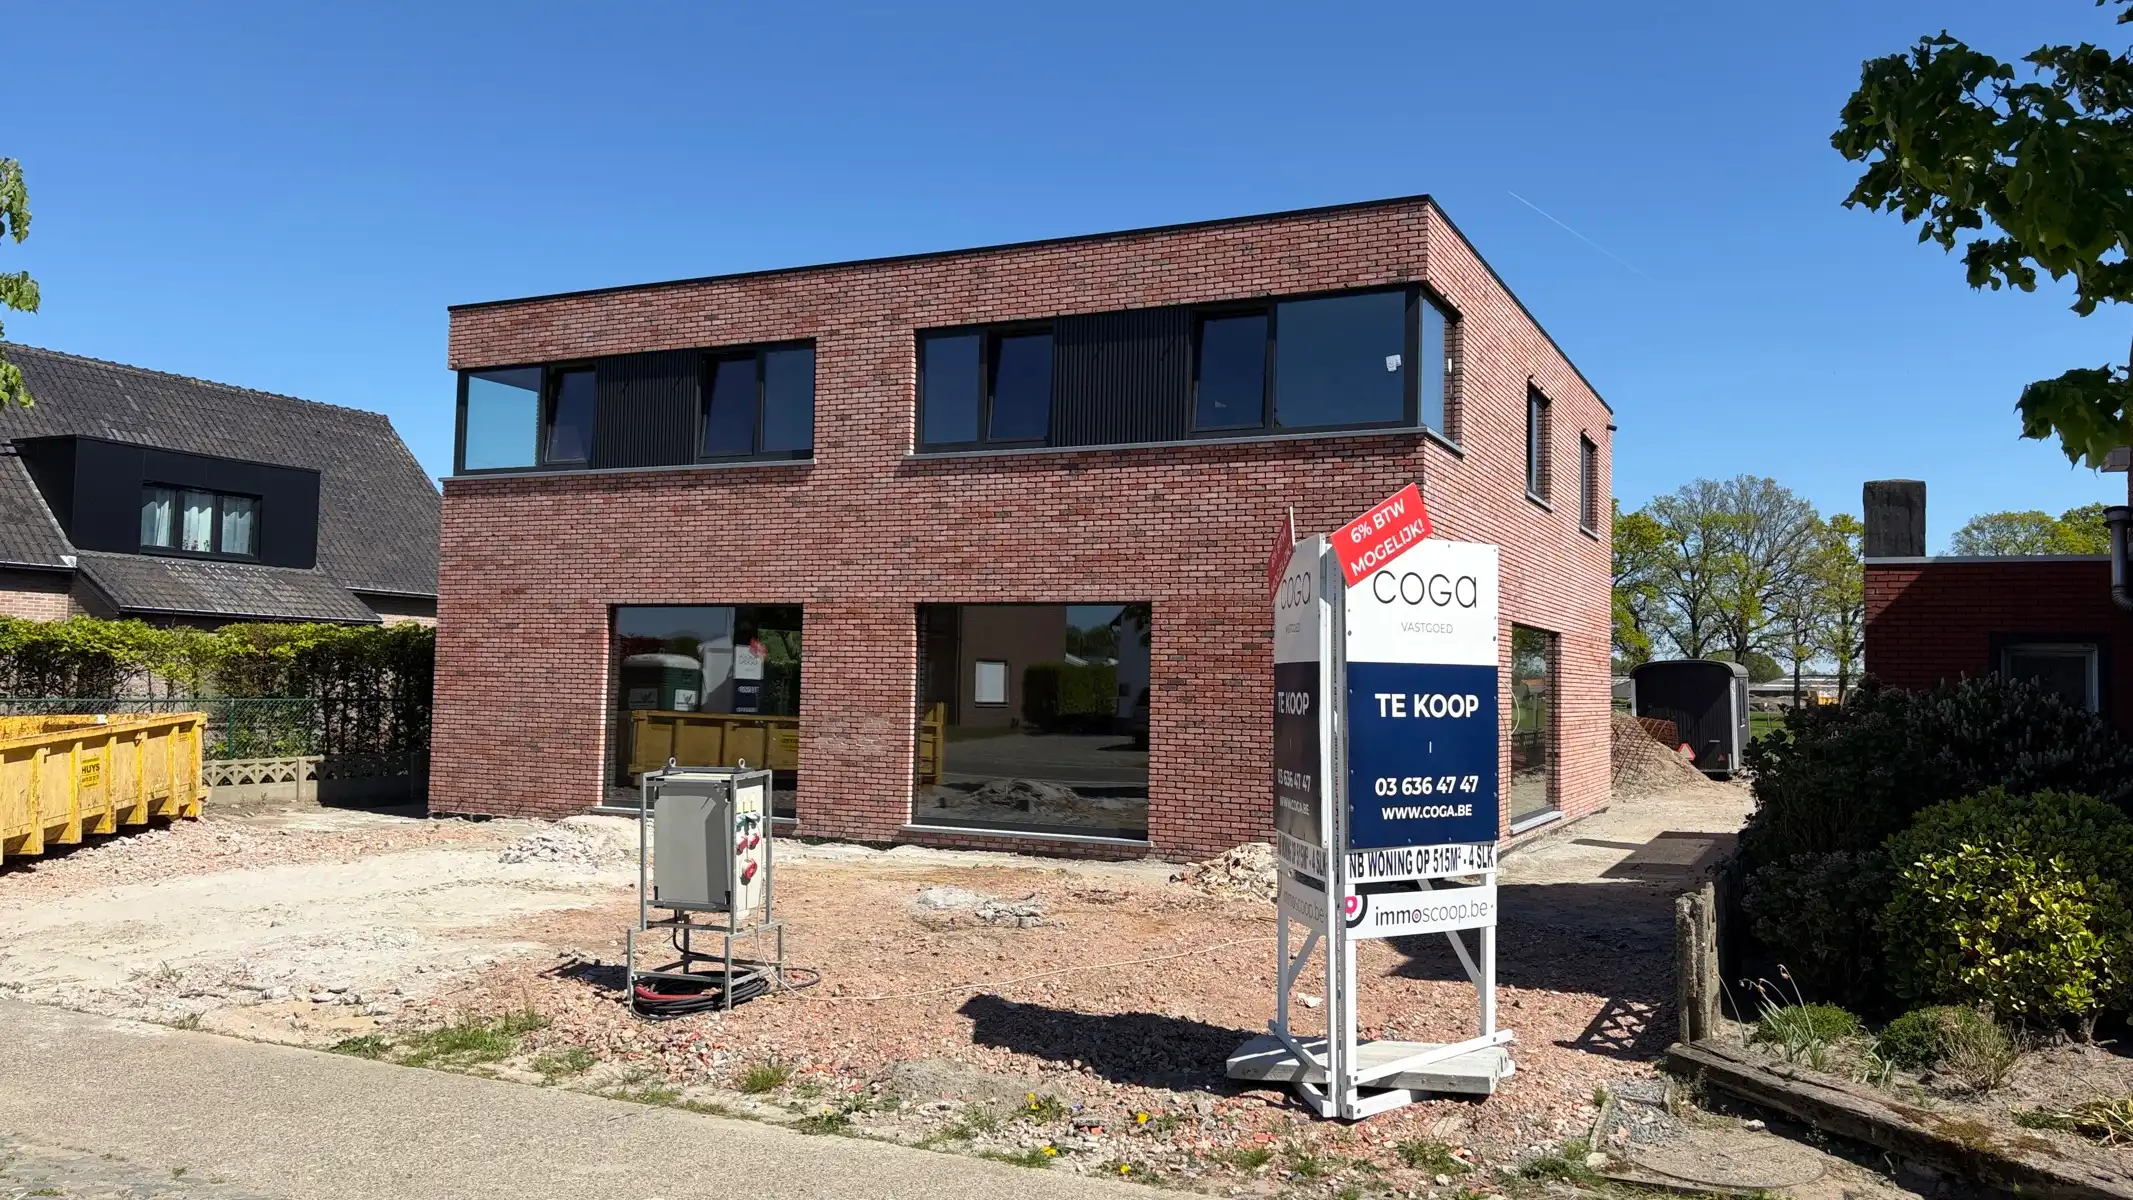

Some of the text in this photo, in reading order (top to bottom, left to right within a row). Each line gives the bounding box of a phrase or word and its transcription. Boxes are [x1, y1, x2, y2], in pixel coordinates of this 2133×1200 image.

[1350, 498, 1406, 544] 6% BTW
[1350, 518, 1426, 577] MOGELIJK!
[1401, 622, 1454, 635] VASTGOED
[1277, 691, 1310, 715] TE KOOP
[1374, 693, 1480, 718] TE KOOP
[82, 763, 100, 775] HUYS
[1302, 774, 1311, 792] 47
[1375, 775, 1479, 796] 03 636 47 47
[1381, 803, 1473, 820] WWW.COGA.BE
[1349, 853, 1365, 879] NB
[1368, 851, 1412, 877] WONING
[1416, 850, 1430, 875] OP
[1468, 848, 1475, 870] 4
[1476, 844, 1494, 869] SLK
[1375, 899, 1489, 927] immoscoop.be
